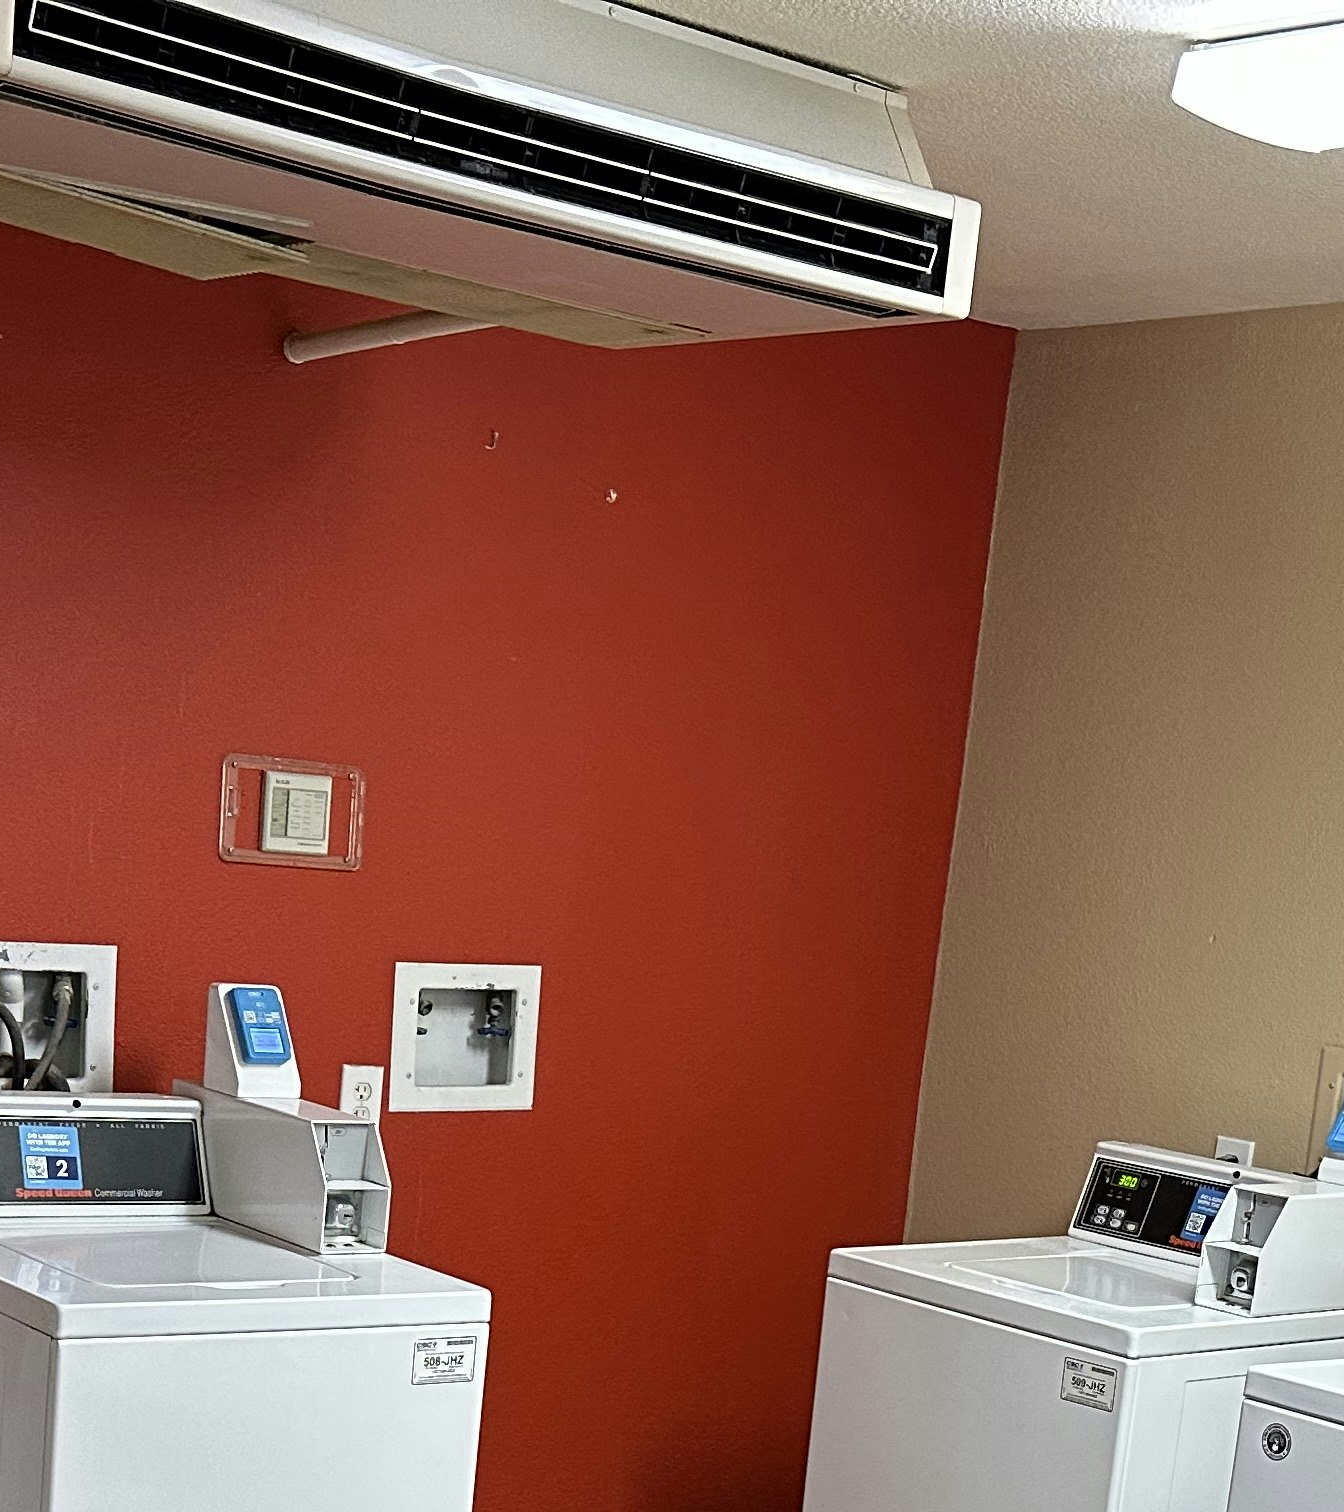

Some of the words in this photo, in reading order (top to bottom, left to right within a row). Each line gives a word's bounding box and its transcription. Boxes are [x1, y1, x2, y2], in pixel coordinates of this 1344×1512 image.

[55, 1159, 69, 1177] 2
[1118, 1174, 1138, 1188] 300
[16, 1187, 53, 1199] Speed
[94, 1188, 136, 1198] Commercial
[136, 1188, 163, 1198] Washer
[1168, 1234, 1196, 1249] Speed
